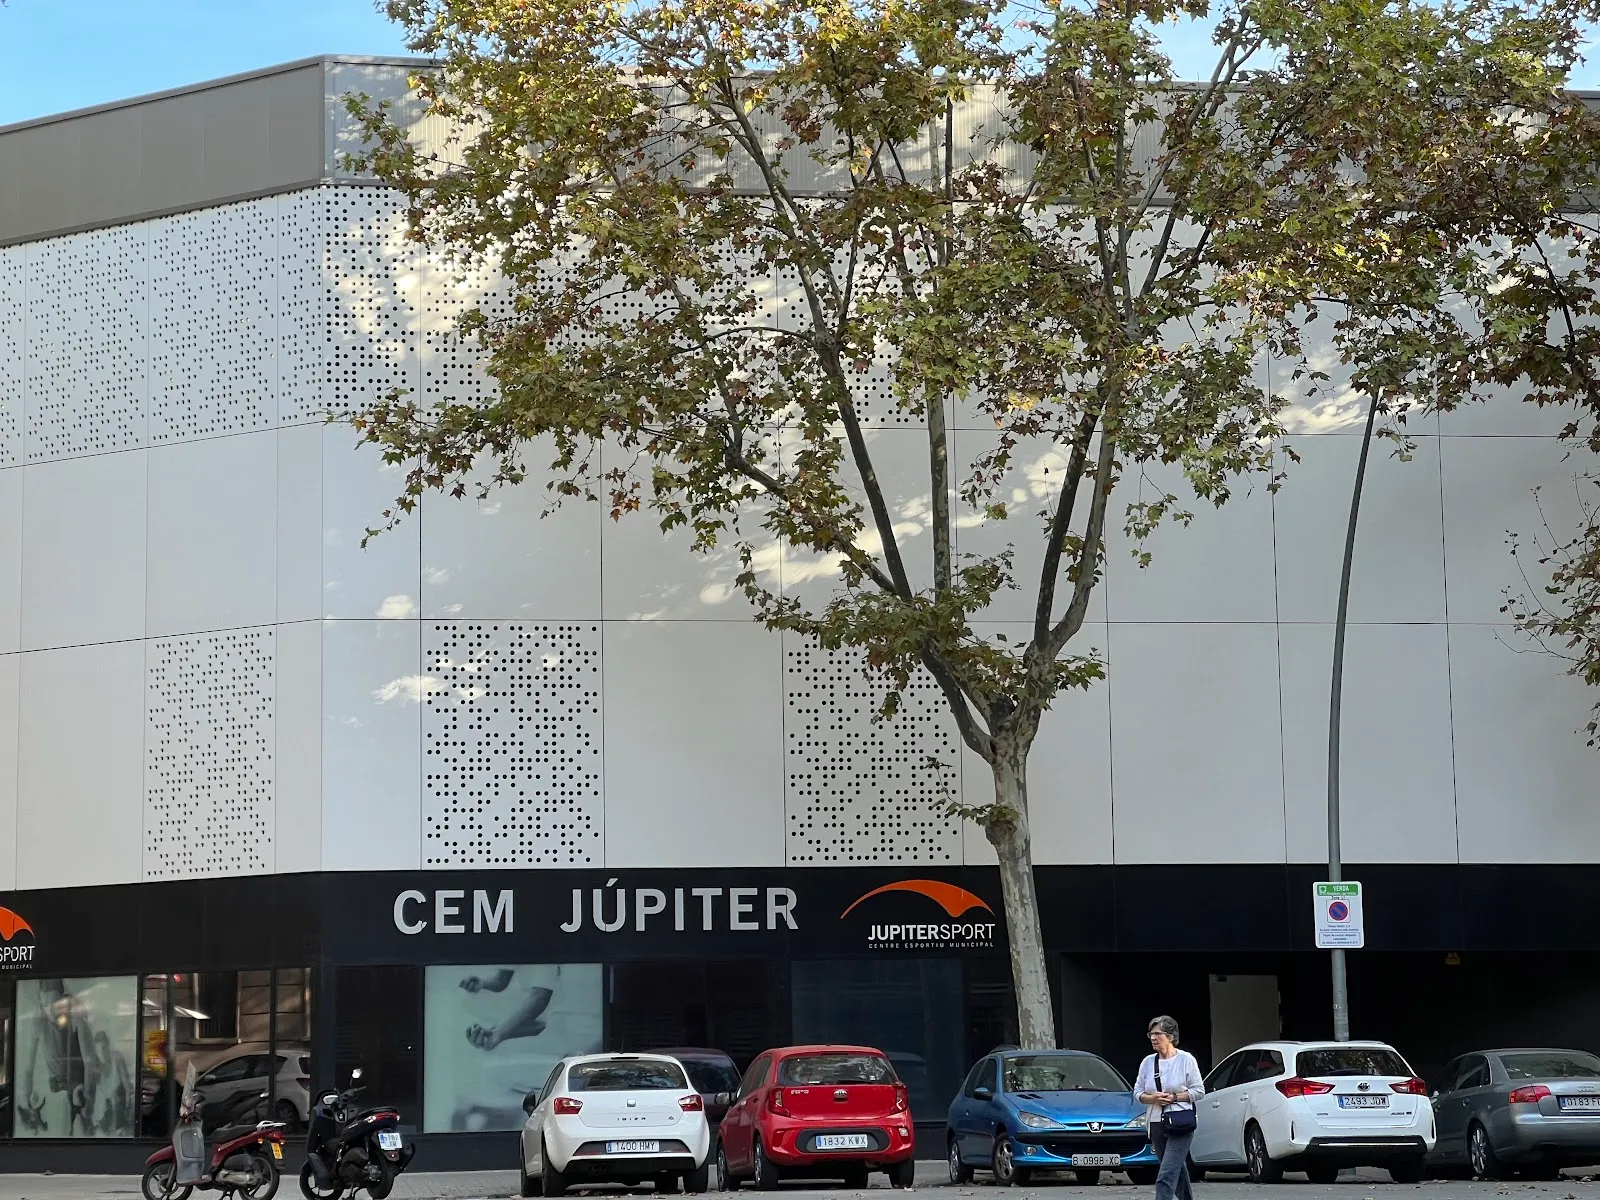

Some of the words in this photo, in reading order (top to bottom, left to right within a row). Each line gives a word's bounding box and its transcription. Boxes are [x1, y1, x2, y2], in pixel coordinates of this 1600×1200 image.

[393, 889, 514, 935] CEM
[559, 877, 799, 933] JÚPITER
[867, 923, 995, 941] JUPITERSPORT
[1345, 1097, 1367, 1106] 2493
[1567, 1097, 1589, 1106] 0183
[615, 1142, 637, 1151] 1400
[640, 1141, 655, 1151] HMY
[823, 1137, 846, 1146] 1832
[848, 1136, 866, 1145] KWX
